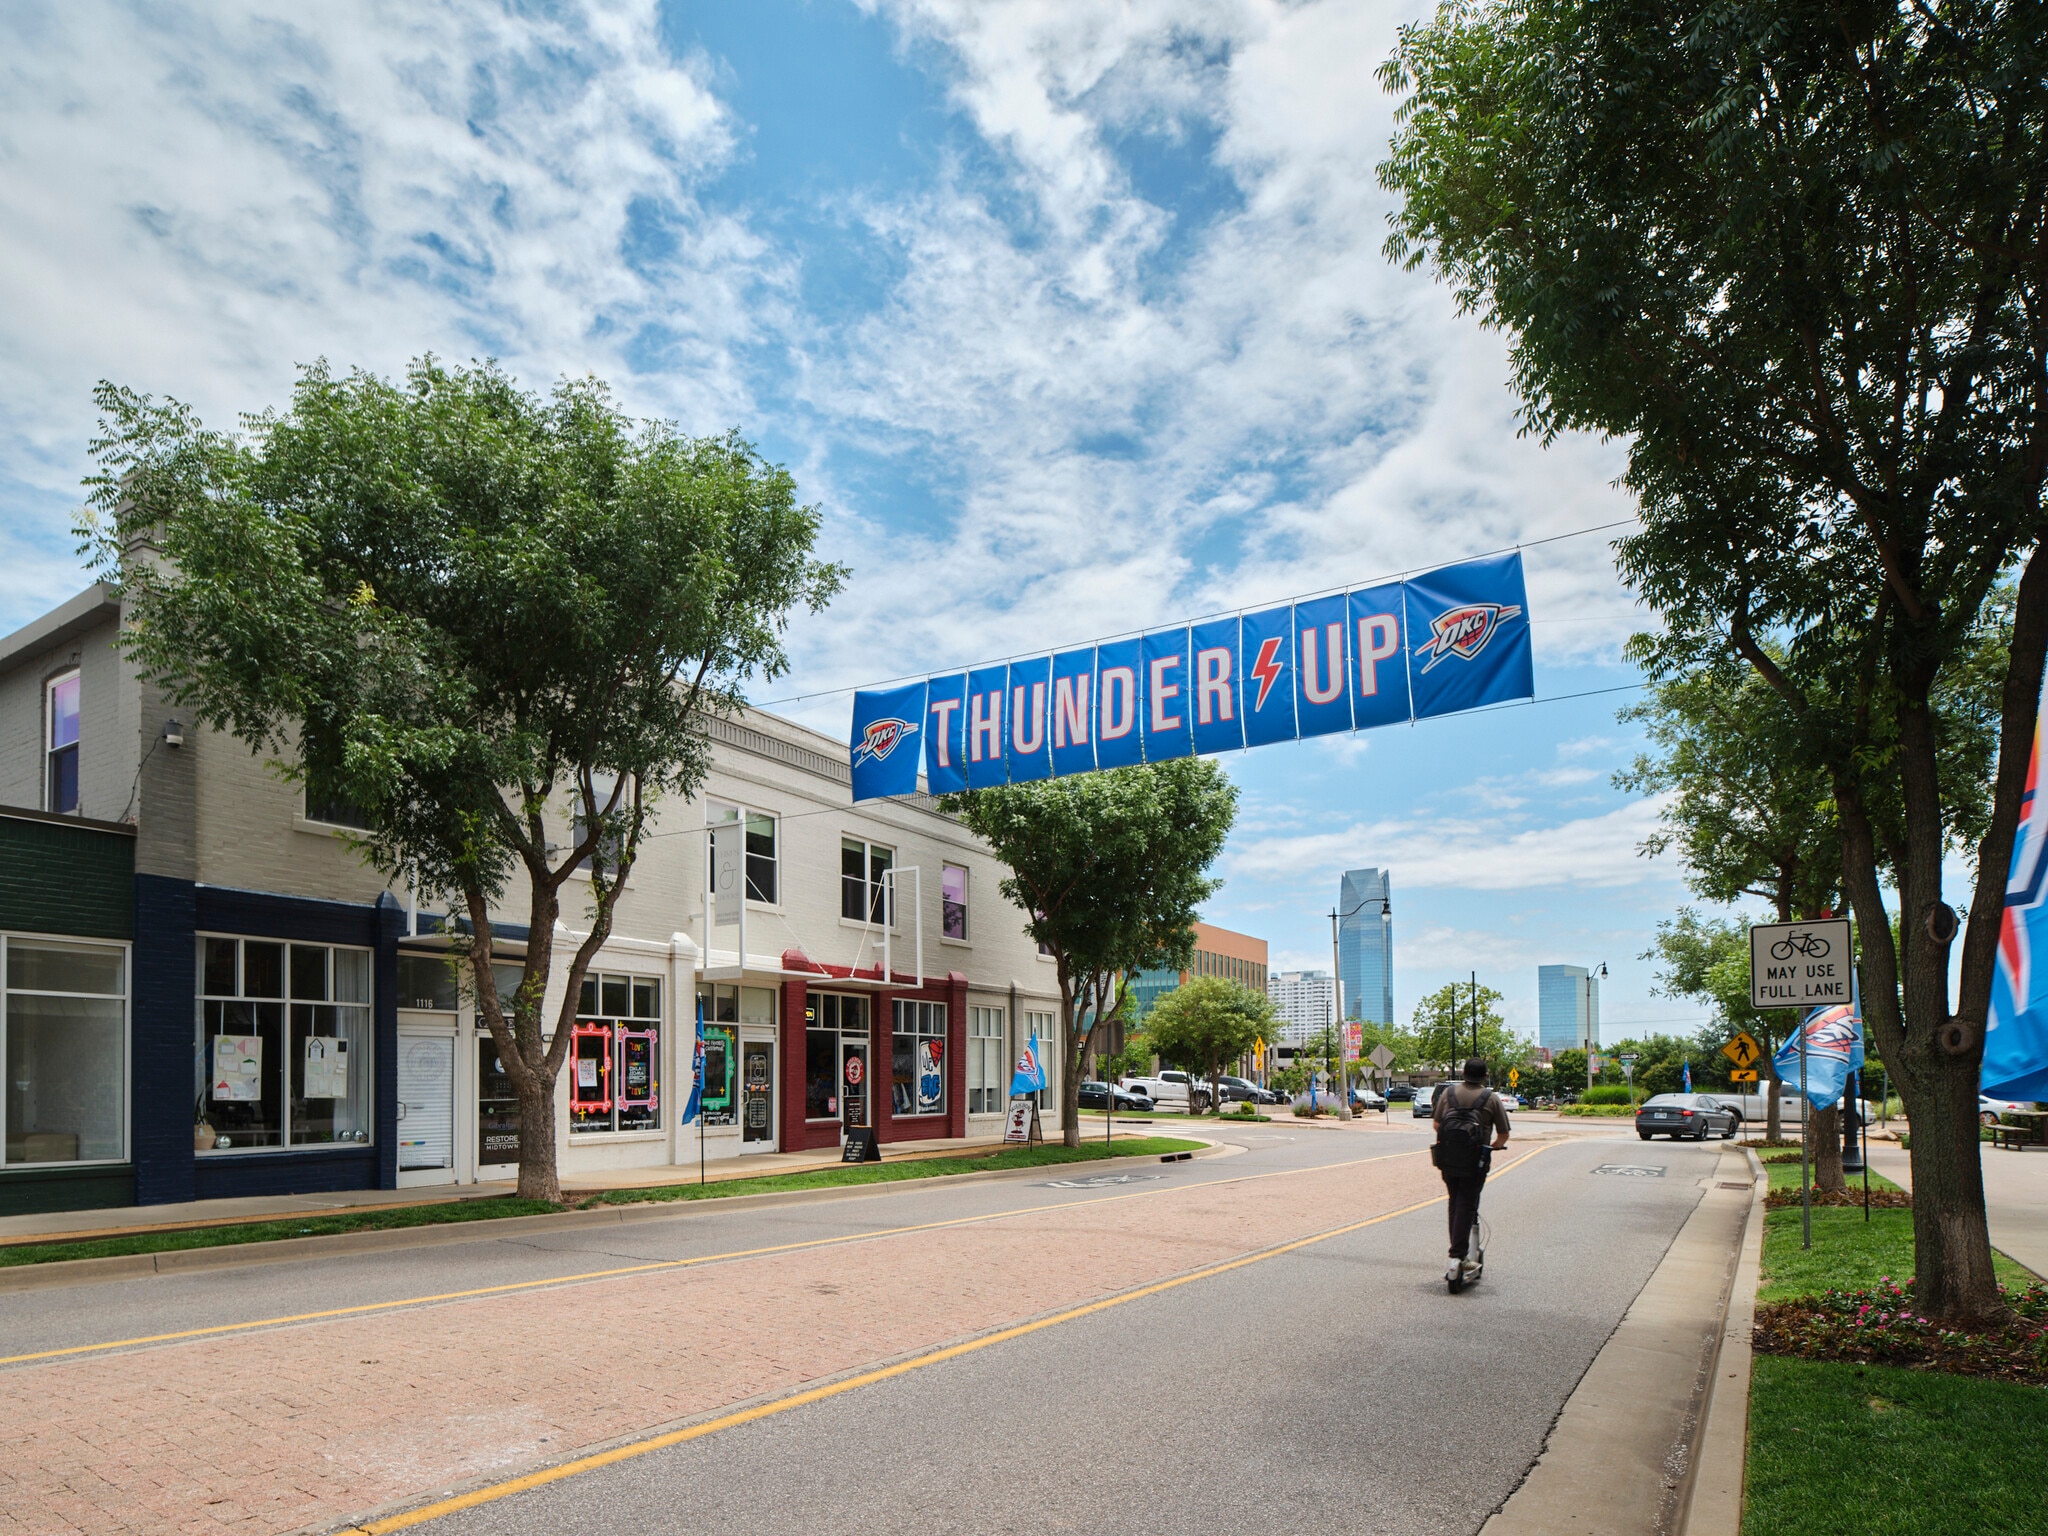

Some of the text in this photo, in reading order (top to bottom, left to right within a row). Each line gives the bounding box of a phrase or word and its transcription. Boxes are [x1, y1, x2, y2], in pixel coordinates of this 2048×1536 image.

[1435, 610, 1486, 655] OKC
[931, 613, 1399, 768] THUNDER UP
[863, 725, 897, 755] OKC
[1767, 963, 1836, 980] MAY USE
[1760, 982, 1844, 999] FULL LANE
[415, 998, 434, 1009] 1116
[486, 1134, 519, 1143] RESTORE
[486, 1143, 519, 1151] MIDTOWN
